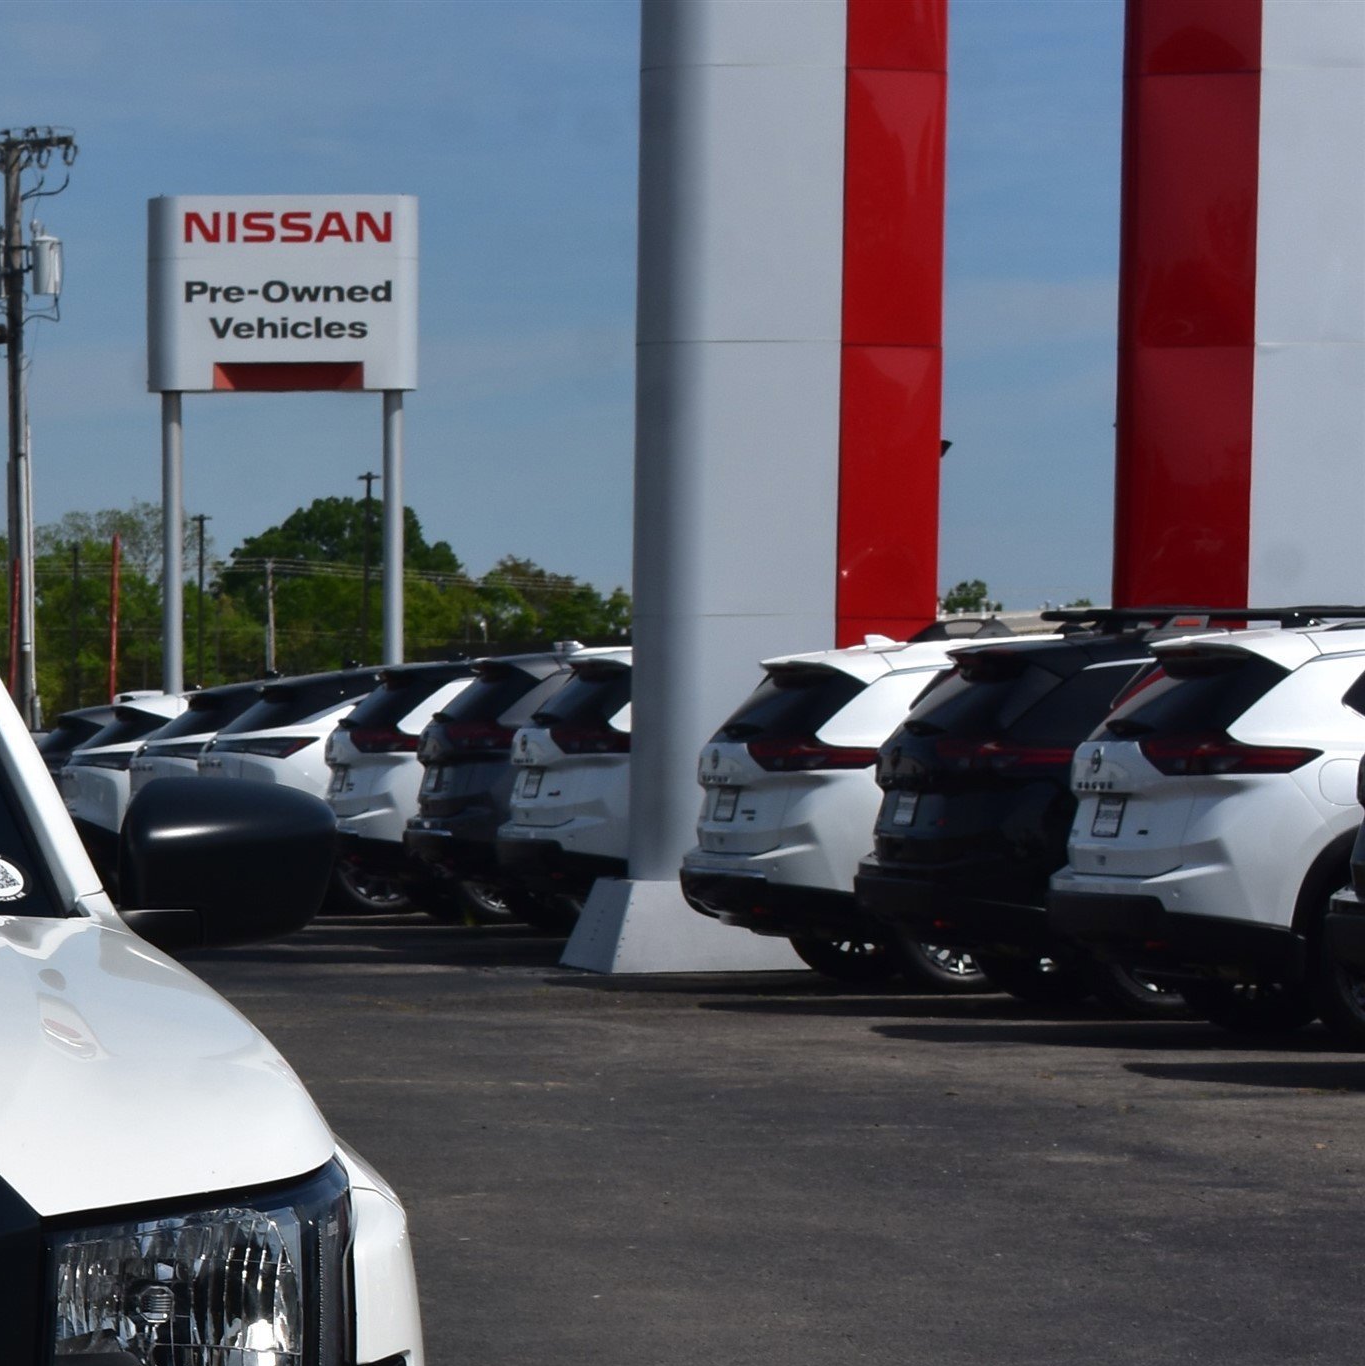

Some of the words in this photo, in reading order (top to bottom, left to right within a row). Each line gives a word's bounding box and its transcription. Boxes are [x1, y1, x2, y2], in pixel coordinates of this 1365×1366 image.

[184, 211, 393, 243] NISSAN
[184, 280, 393, 303] Pre-Owned
[209, 317, 368, 339] Vehicles
